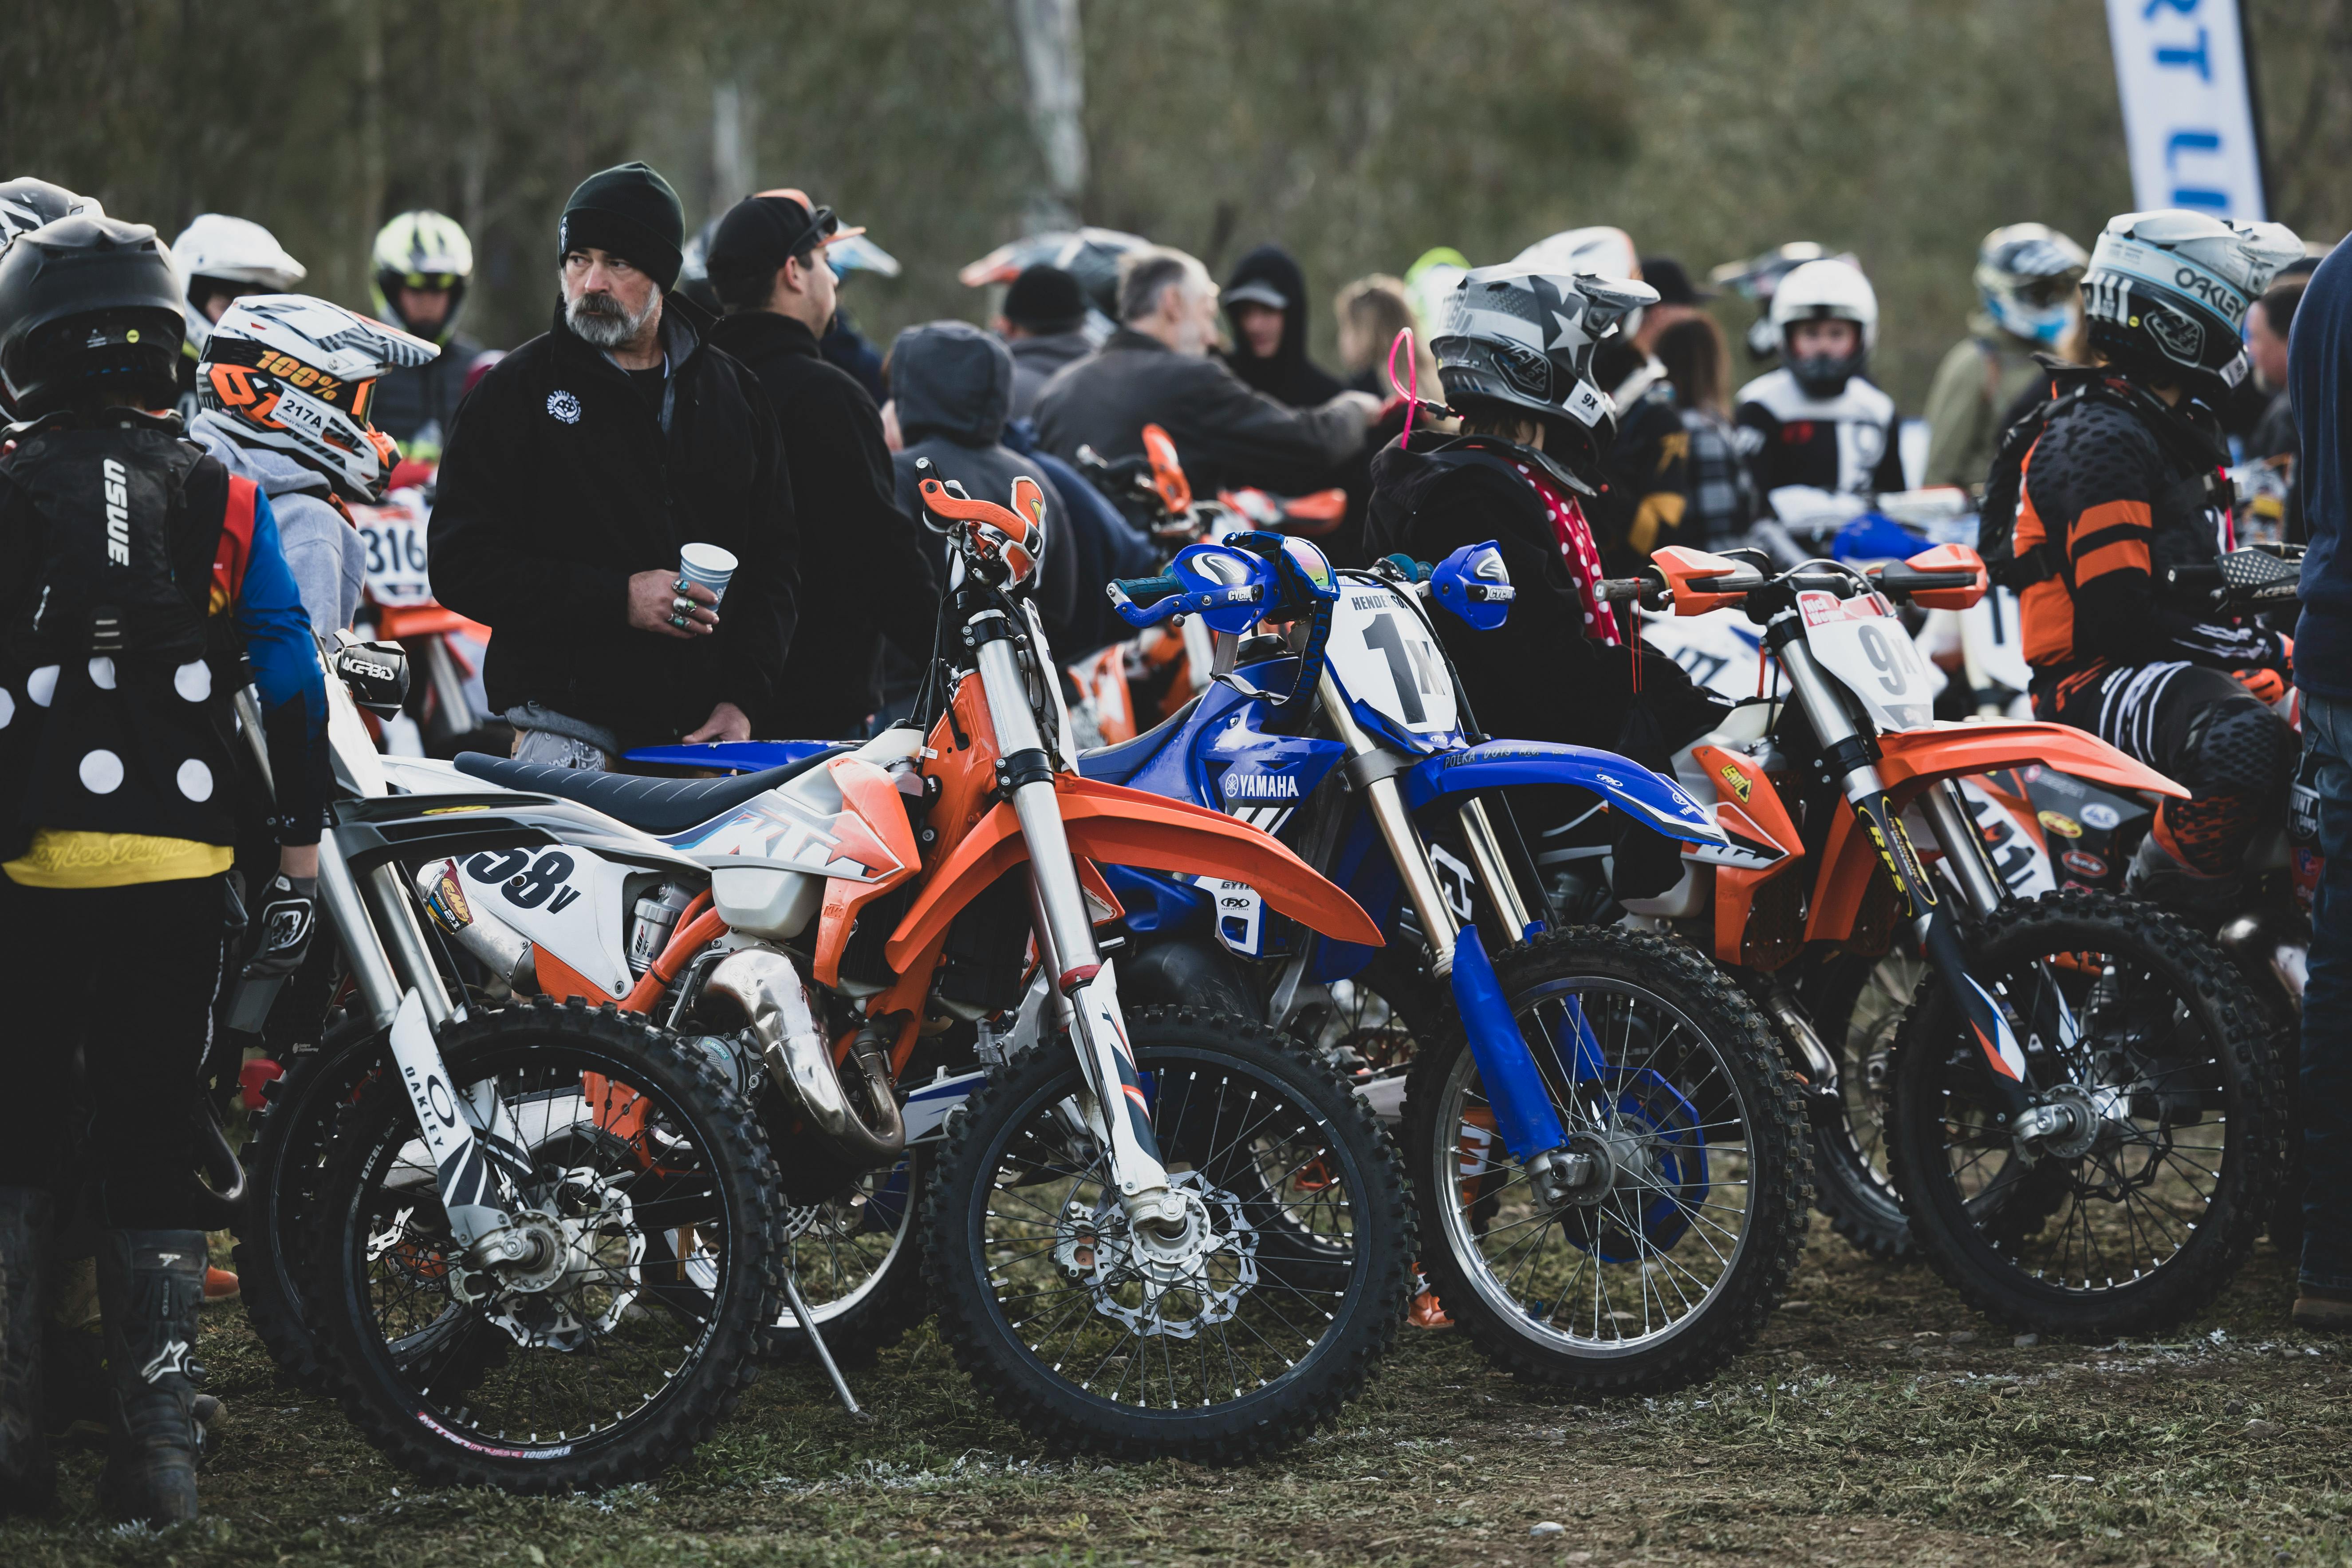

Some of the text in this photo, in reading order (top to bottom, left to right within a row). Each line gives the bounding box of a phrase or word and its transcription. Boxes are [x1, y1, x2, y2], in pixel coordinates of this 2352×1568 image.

[2175, 268, 2244, 323] OAKLEY
[256, 350, 342, 401] 100%
[283, 399, 322, 429] 217A
[1581, 393, 1598, 410] 9X
[103, 458, 130, 567] USWE
[358, 526, 427, 573] 316
[1351, 595, 1408, 611] HENDERSO
[340, 657, 395, 681] ACERBIS
[1445, 750, 1476, 770] POLKA
[1483, 747, 1513, 759] DOTS
[1240, 775, 1300, 797] YAMAHA
[1869, 827, 1906, 893] RPS
[434, 890, 447, 910] POWER
[441, 878, 472, 922] FMF
[710, 1040, 729, 1060] MOTOREX
[405, 1066, 445, 1147] OAKLEY
[360, 1142, 385, 1181] EXCEL
[522, 1445, 573, 1460] EQUIPPED
